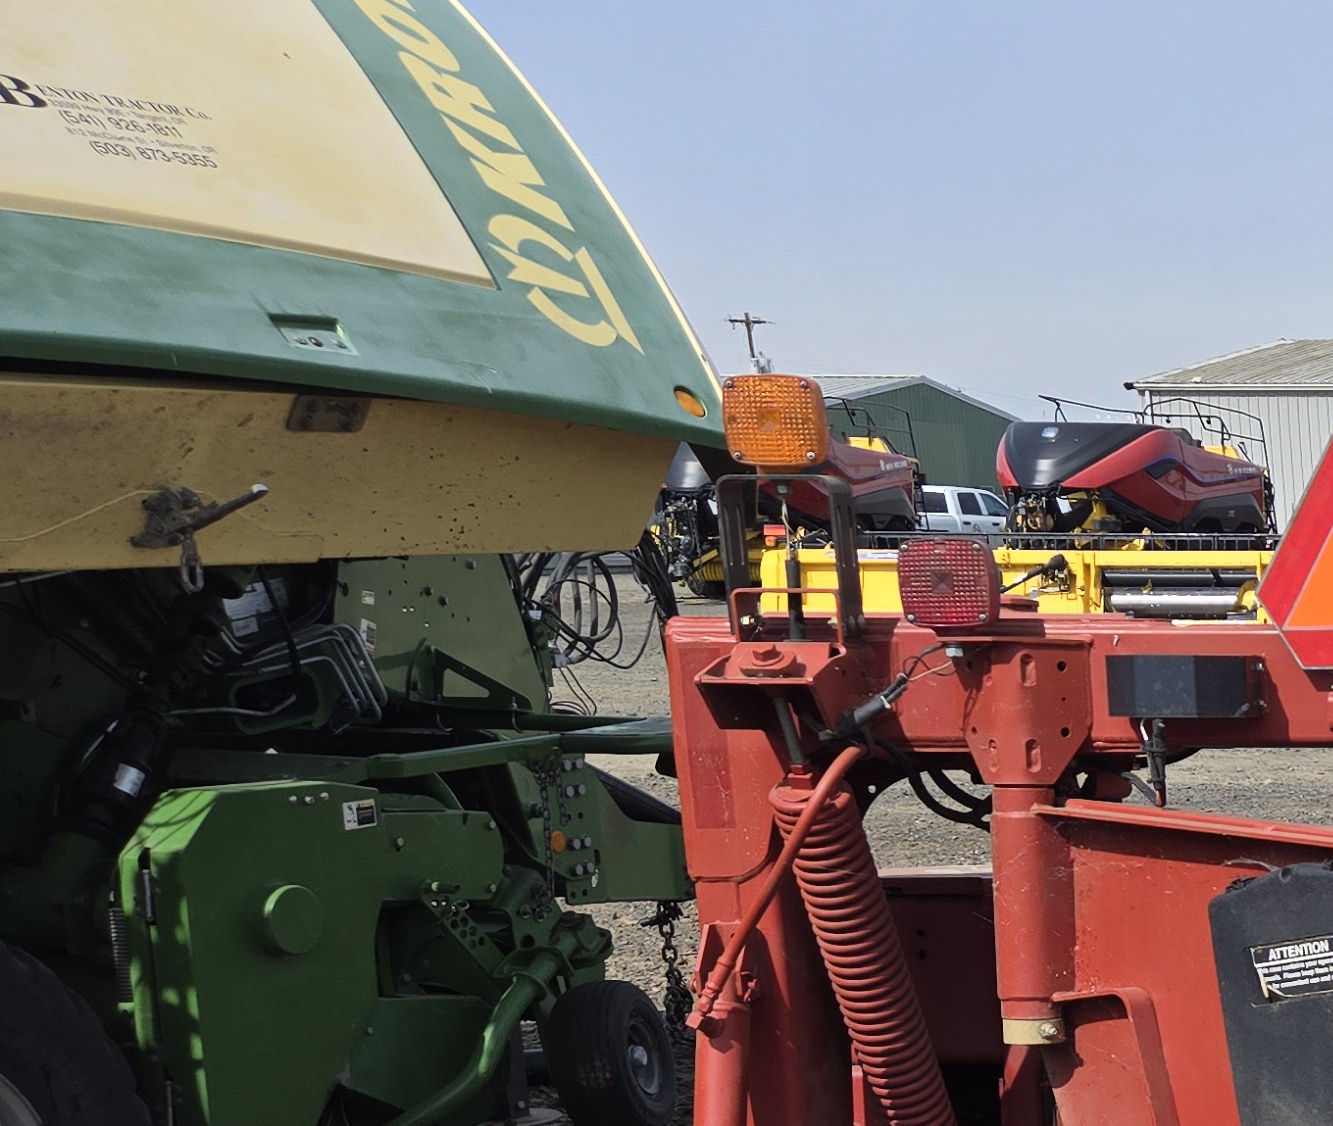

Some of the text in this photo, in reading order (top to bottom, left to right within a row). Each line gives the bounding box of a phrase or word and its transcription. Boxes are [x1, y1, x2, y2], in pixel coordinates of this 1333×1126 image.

[99, 94, 186, 117] TRACTOR
[356, 0, 576, 233] KRO
[58, 109, 183, 138] (541) 926-1811
[88, 140, 218, 168] (503) 873-5355
[1268, 939, 1330, 961] ATTENTION
